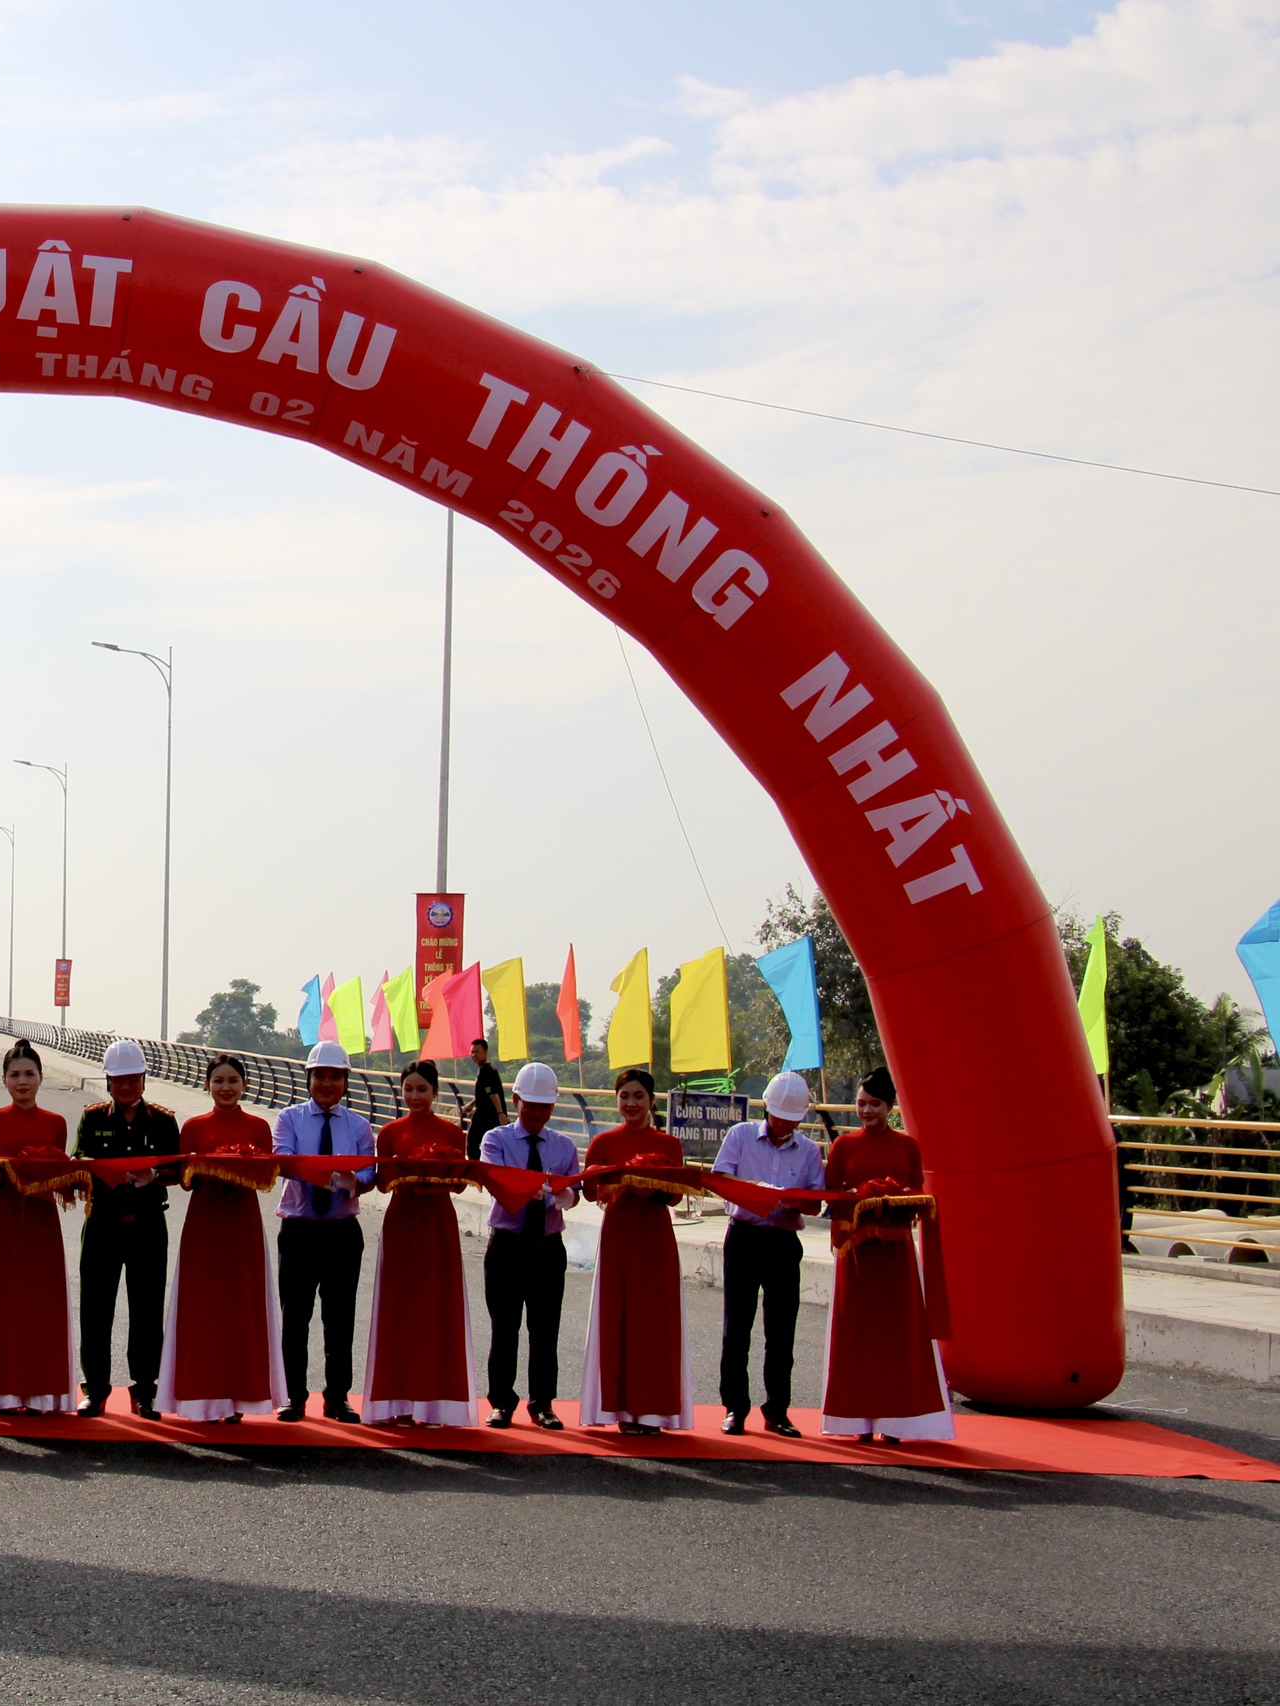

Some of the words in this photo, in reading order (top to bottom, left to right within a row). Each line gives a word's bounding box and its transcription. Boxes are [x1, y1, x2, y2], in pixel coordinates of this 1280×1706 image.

[35, 349, 214, 401] THÁNG
[249, 391, 315, 425] 02
[342, 420, 473, 498] NĂM
[498, 499, 621, 599] 2026
[200, 276, 397, 390] CẦU
[468, 373, 768, 630] THỐNG
[781, 651, 983, 904] NHẤT
[421, 937, 438, 947] CHÀO
[439, 937, 458, 947] MỪNG
[435, 948, 443, 959] LỄ
[424, 962, 444, 972] THÔNG
[676, 1103, 703, 1119] CÔNG
[705, 1105, 742, 1122] TRƯỜNG
[672, 1127, 700, 1140] ĐANG
[703, 1128, 717, 1141] THI
